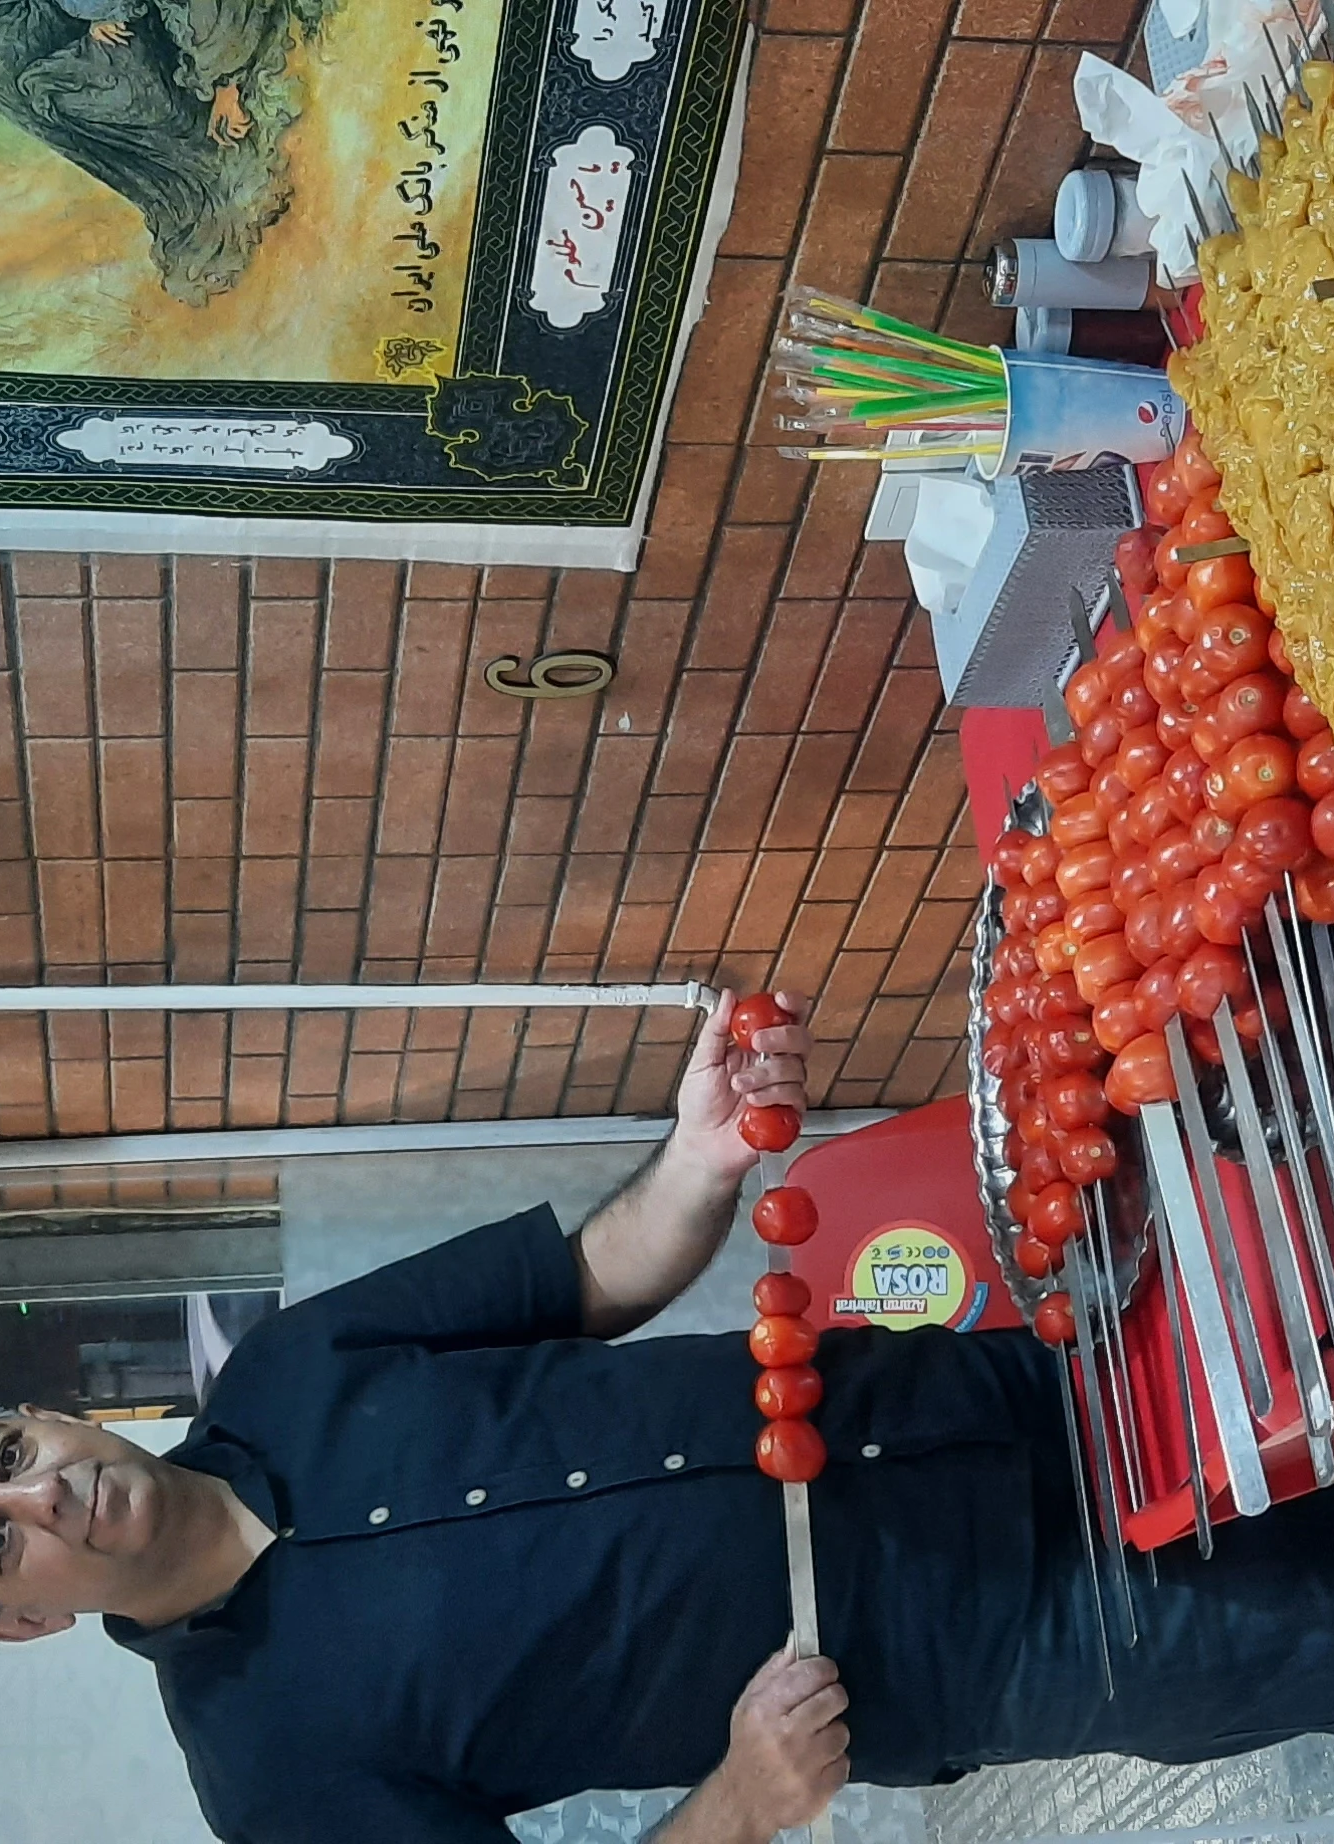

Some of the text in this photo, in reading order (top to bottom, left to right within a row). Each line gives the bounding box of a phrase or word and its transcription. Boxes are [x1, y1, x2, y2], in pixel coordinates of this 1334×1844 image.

[413, 18, 461, 64] نهی
[592, 27, 614, 42] را
[407, 70, 449, 93] از
[396, 99, 446, 156] منکر
[394, 161, 448, 216] بانک
[392, 221, 441, 260] ملی
[545, 160, 620, 289] یا حسین مظلوم
[389, 265, 436, 314] ایران
[202, 445, 214, 457] را
[484, 651, 615, 698] 6
[871, 1264, 948, 1295] ROSA
